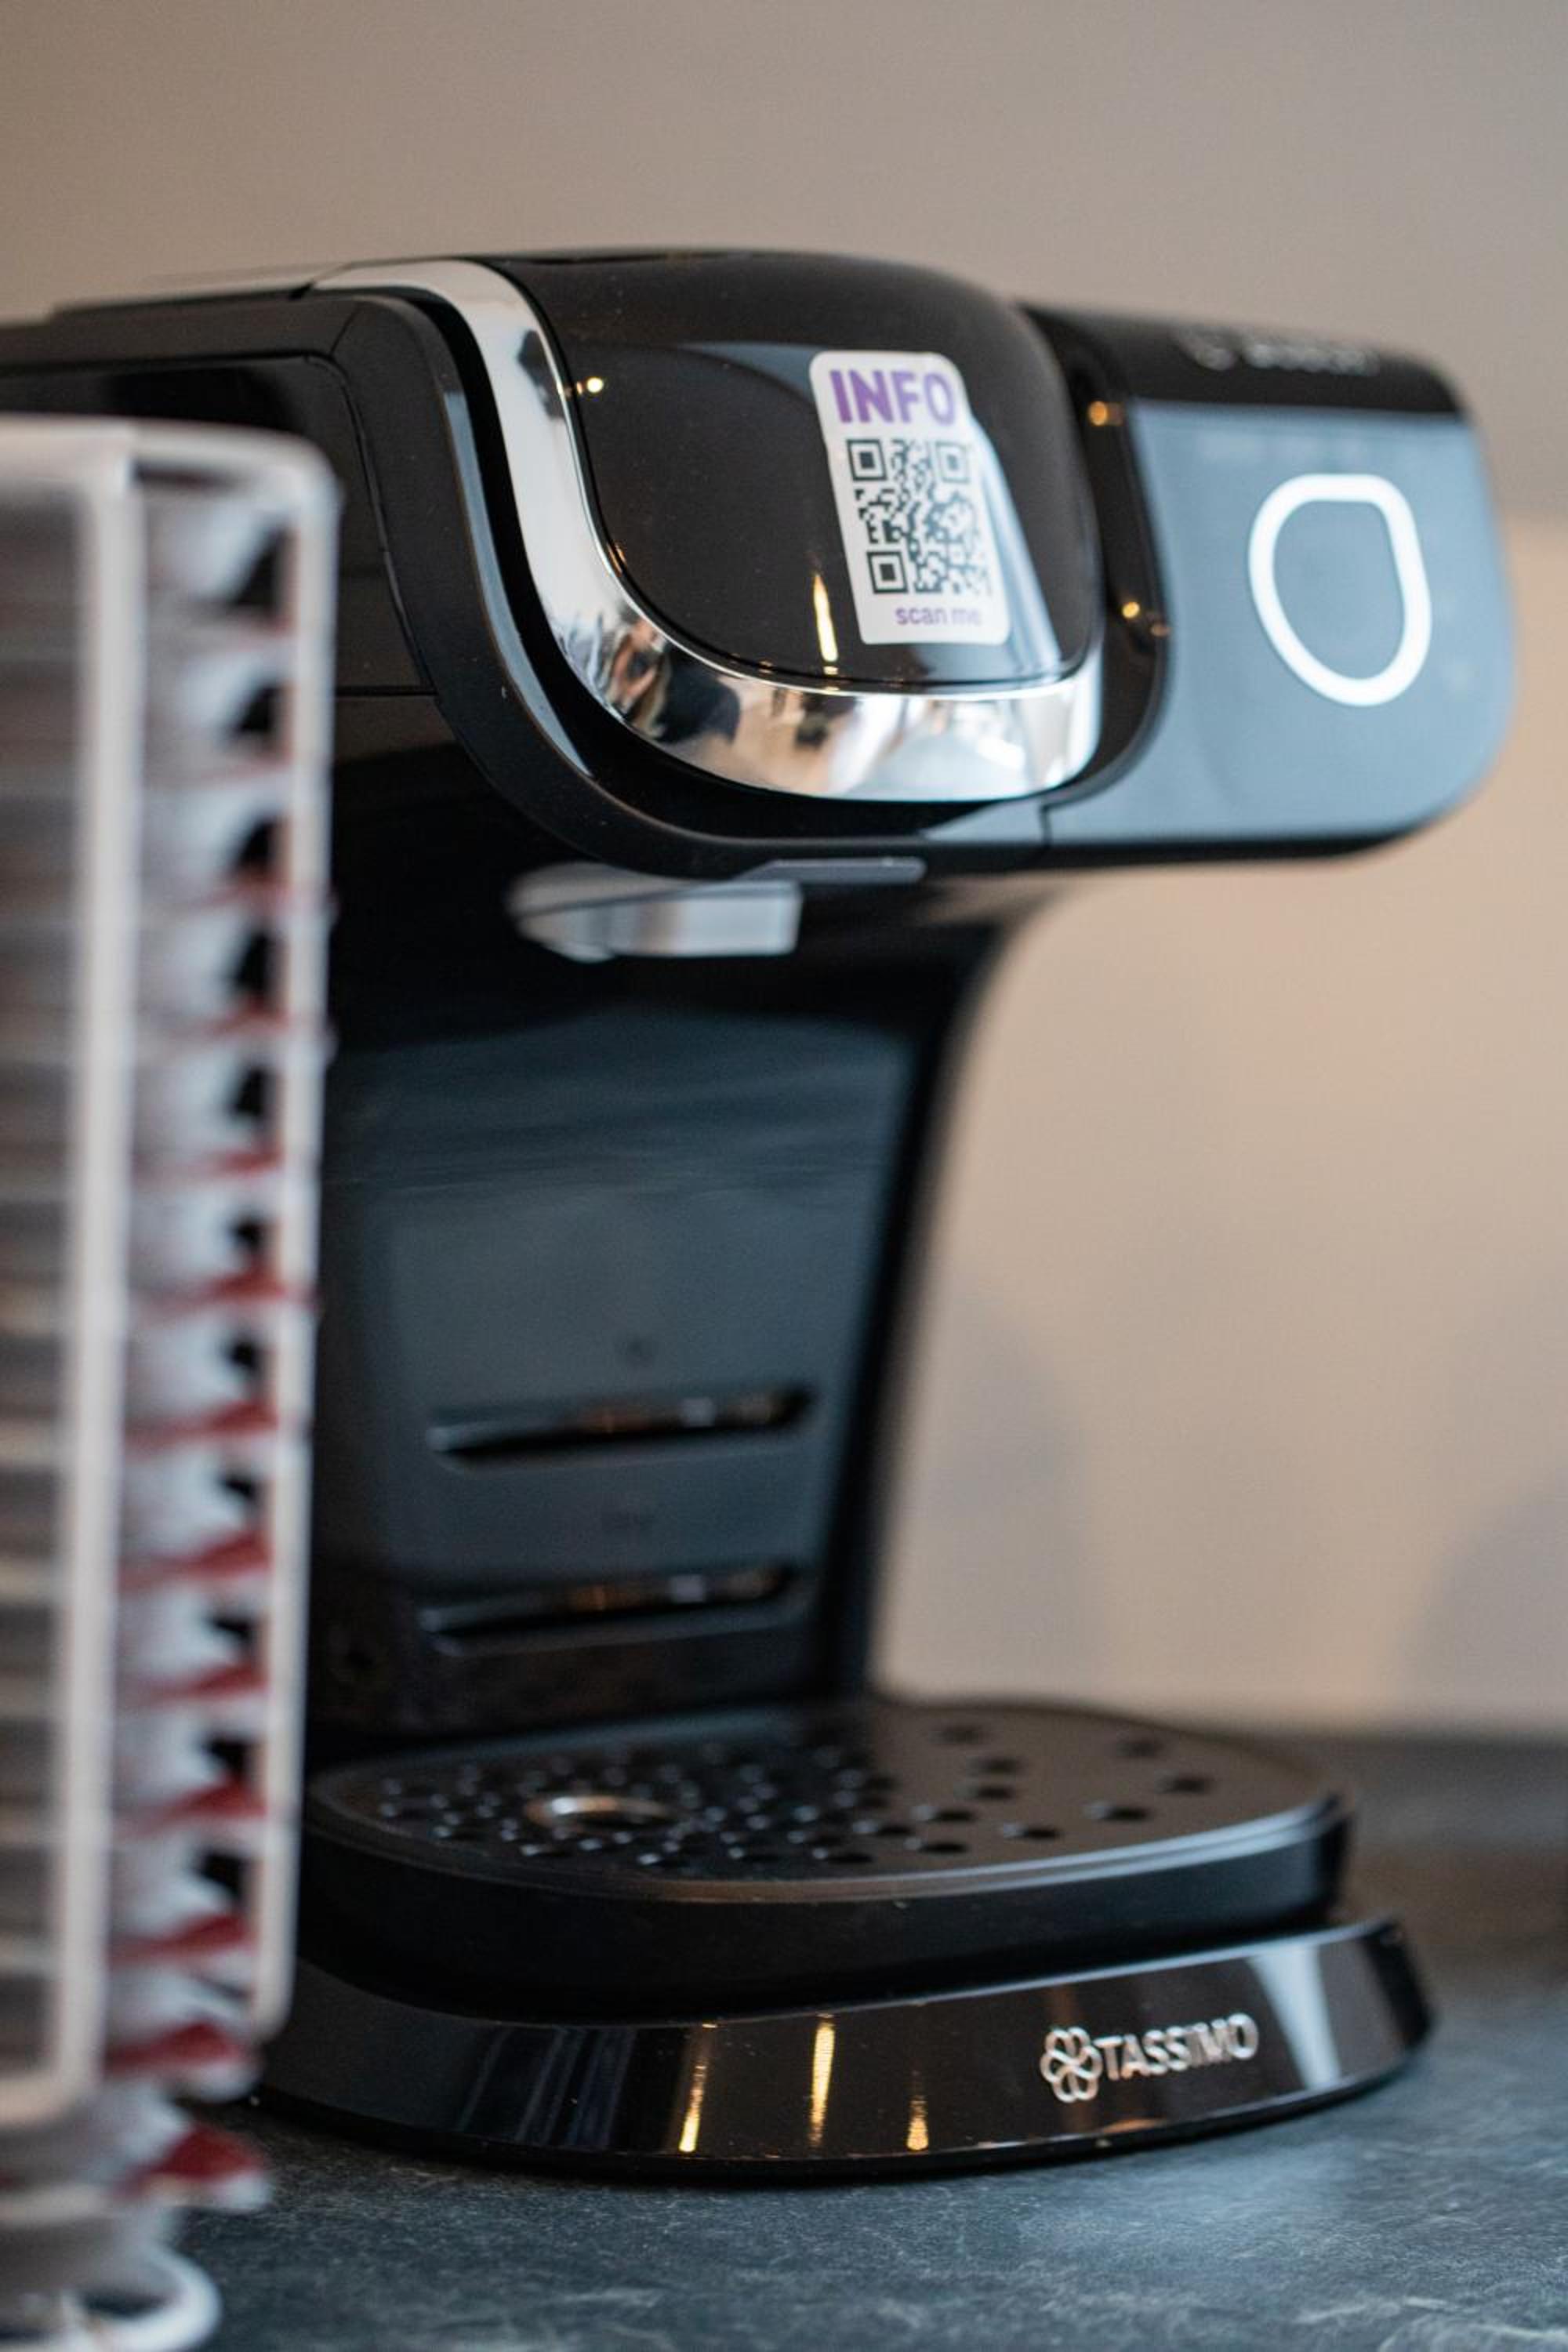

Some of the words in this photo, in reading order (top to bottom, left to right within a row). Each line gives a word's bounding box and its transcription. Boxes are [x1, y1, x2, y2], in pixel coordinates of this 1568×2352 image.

[829, 370, 956, 426] INFO
[895, 607, 947, 625] scan
[951, 608, 982, 626] me
[1093, 2013, 1259, 2081] TASSIMO
